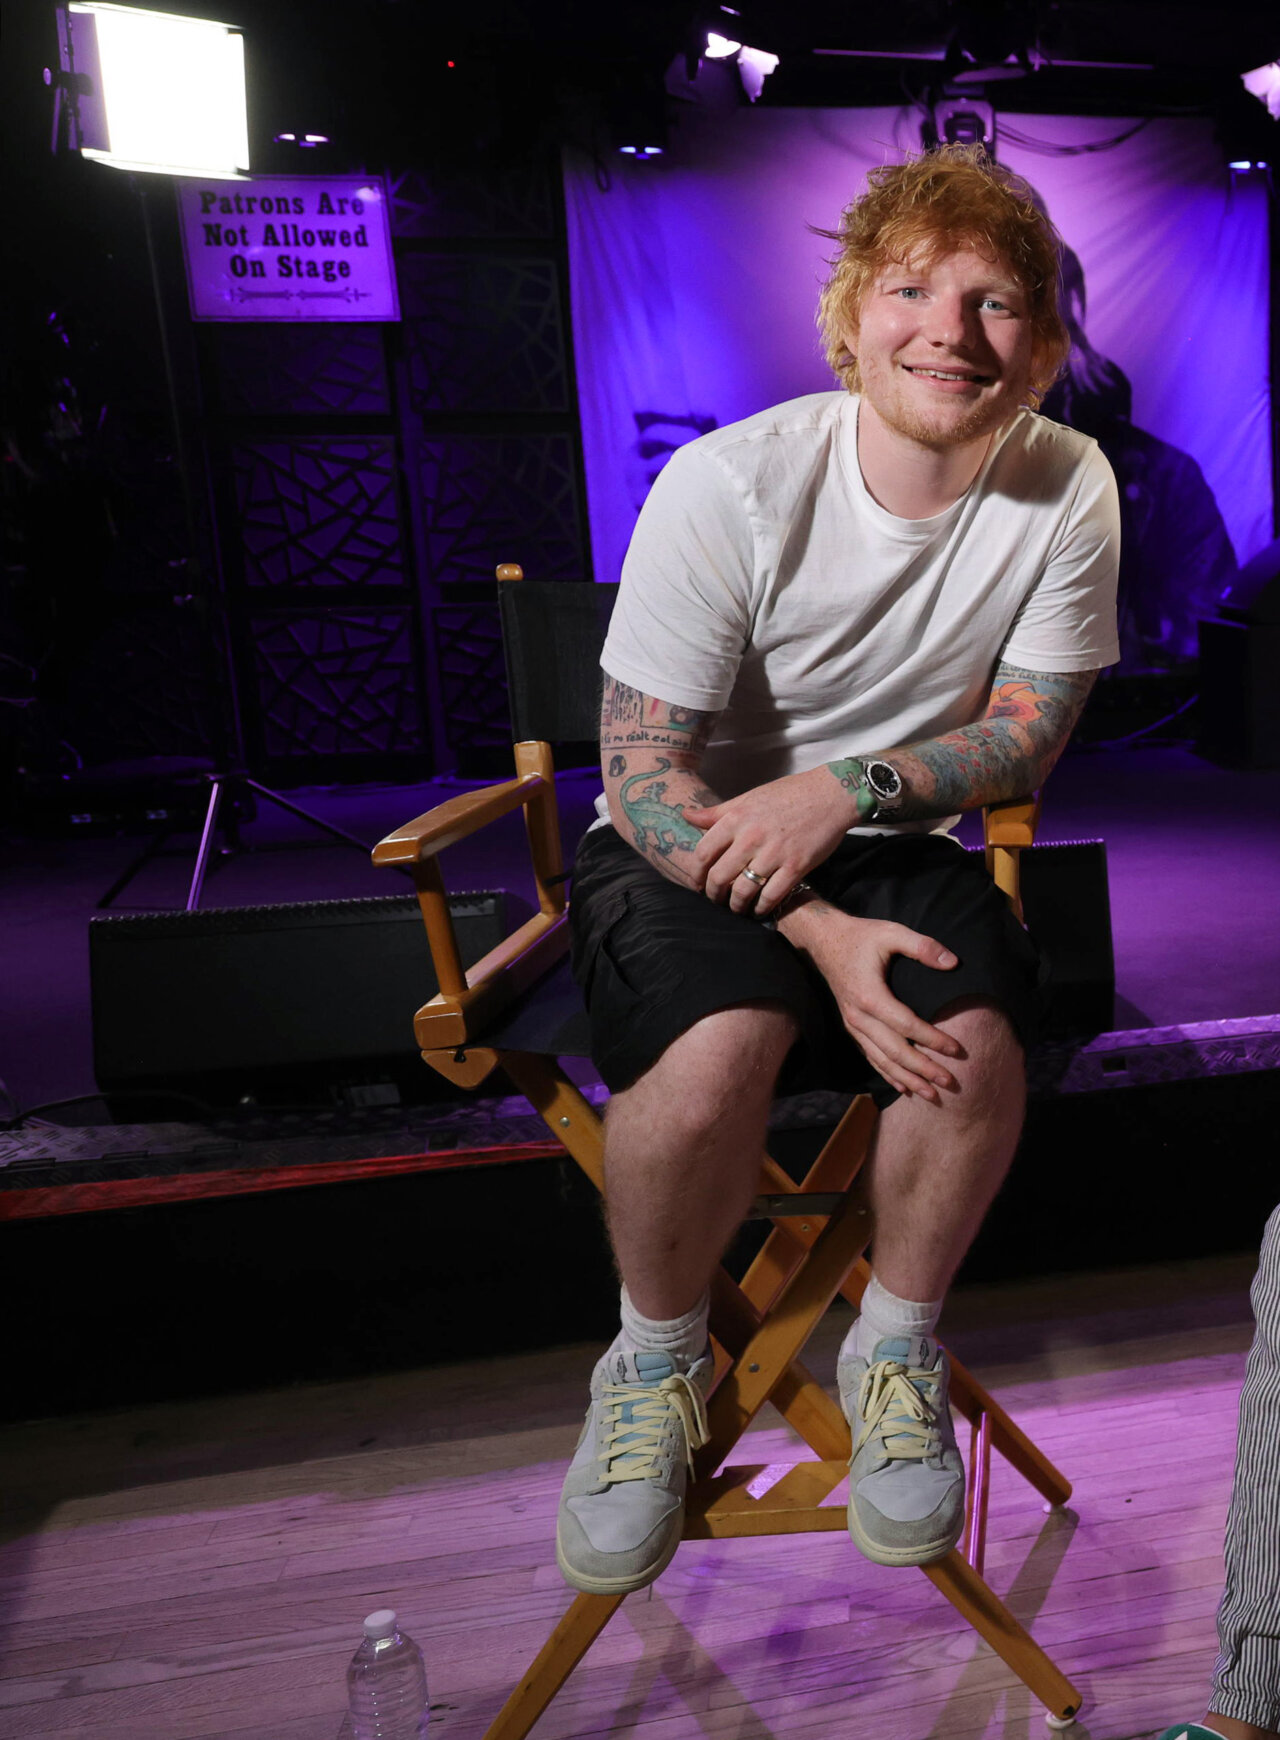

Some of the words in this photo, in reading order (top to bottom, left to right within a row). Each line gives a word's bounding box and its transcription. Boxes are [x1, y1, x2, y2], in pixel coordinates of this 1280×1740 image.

[201, 190, 304, 215] Patrons
[316, 192, 365, 215] Are
[203, 223, 249, 247] Not
[263, 224, 368, 247] Allowed
[230, 255, 266, 278] On
[277, 255, 350, 283] Stage
